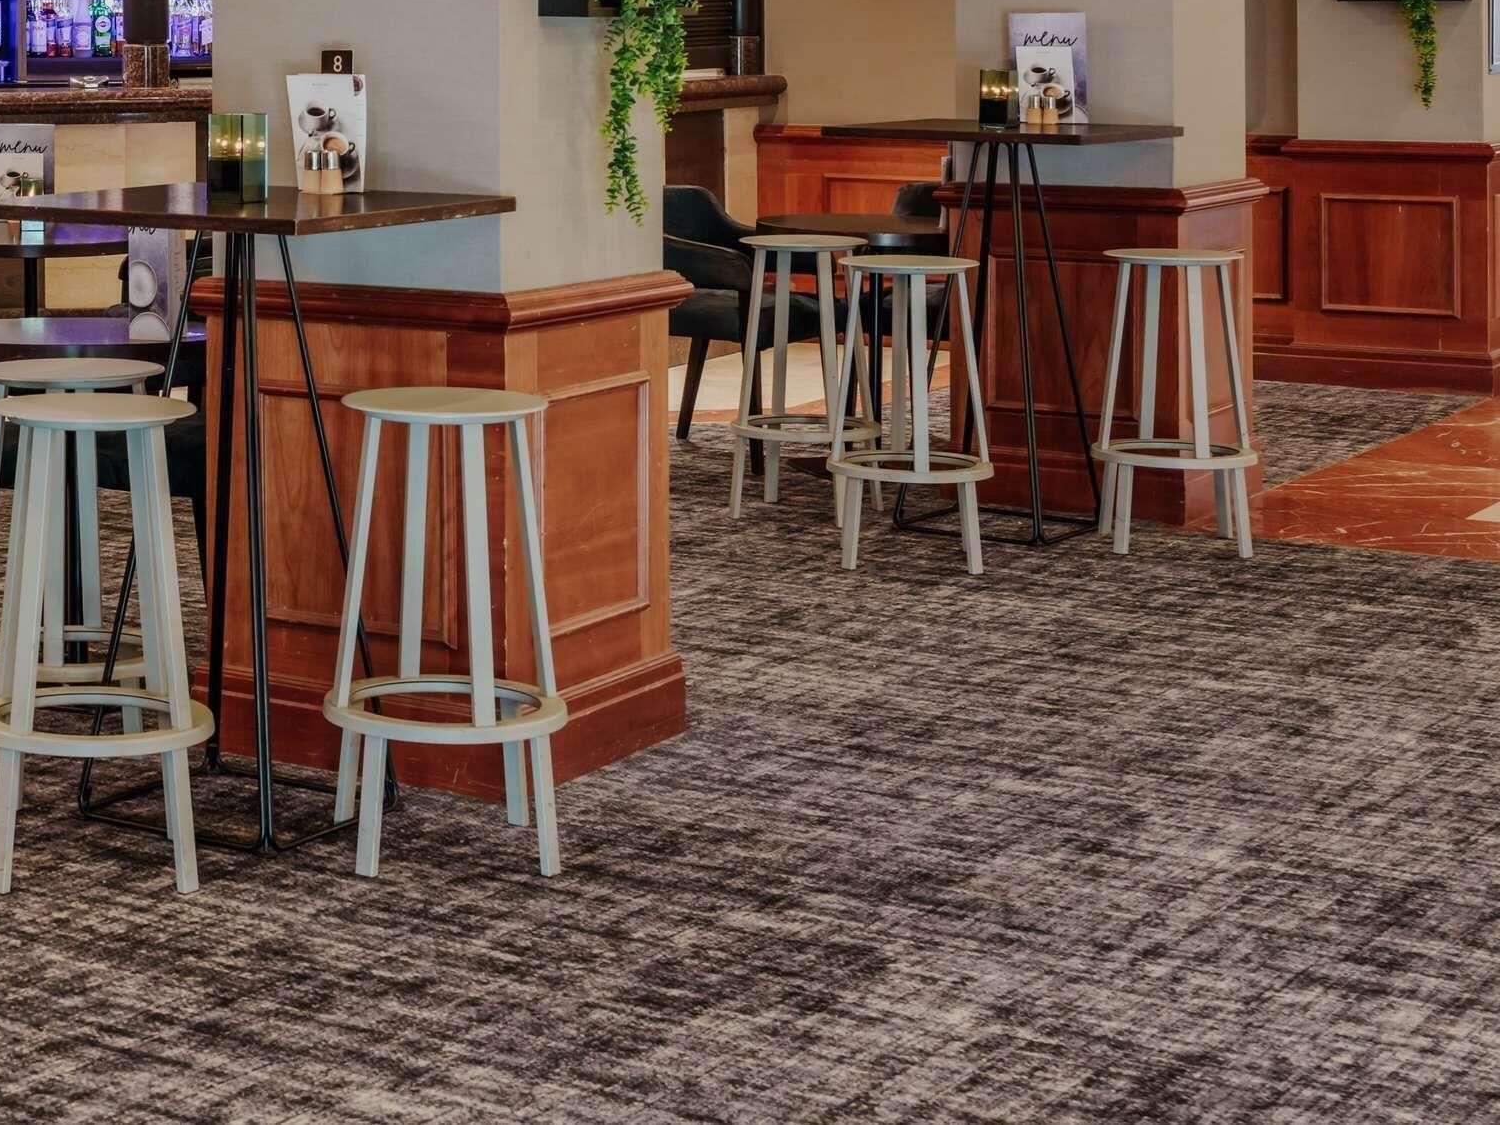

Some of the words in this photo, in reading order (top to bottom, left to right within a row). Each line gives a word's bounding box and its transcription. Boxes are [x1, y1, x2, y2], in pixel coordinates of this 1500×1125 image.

[1023, 31, 1078, 47] menu
[333, 55, 342, 73] 8
[0, 141, 48, 154] menu
